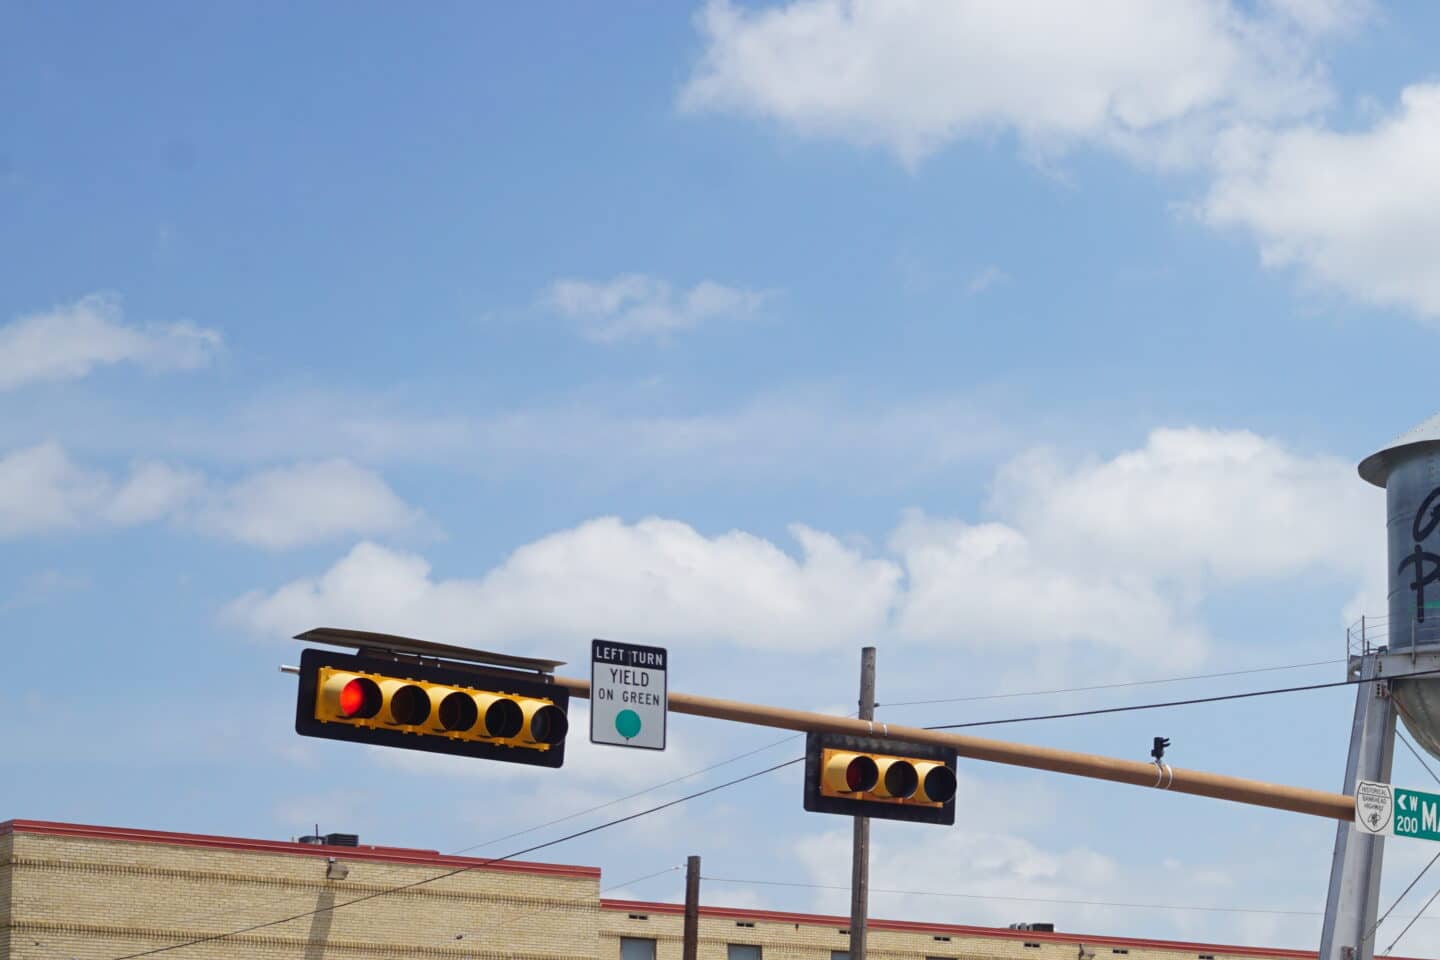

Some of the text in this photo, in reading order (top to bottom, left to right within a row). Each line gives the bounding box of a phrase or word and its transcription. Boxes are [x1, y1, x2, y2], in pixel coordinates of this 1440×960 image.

[596, 645, 664, 666] LEFT TURN
[609, 668, 650, 687] YIELD
[598, 687, 660, 706] ON GREEN
[1409, 795, 1419, 812] W
[1396, 815, 1418, 834] 200
